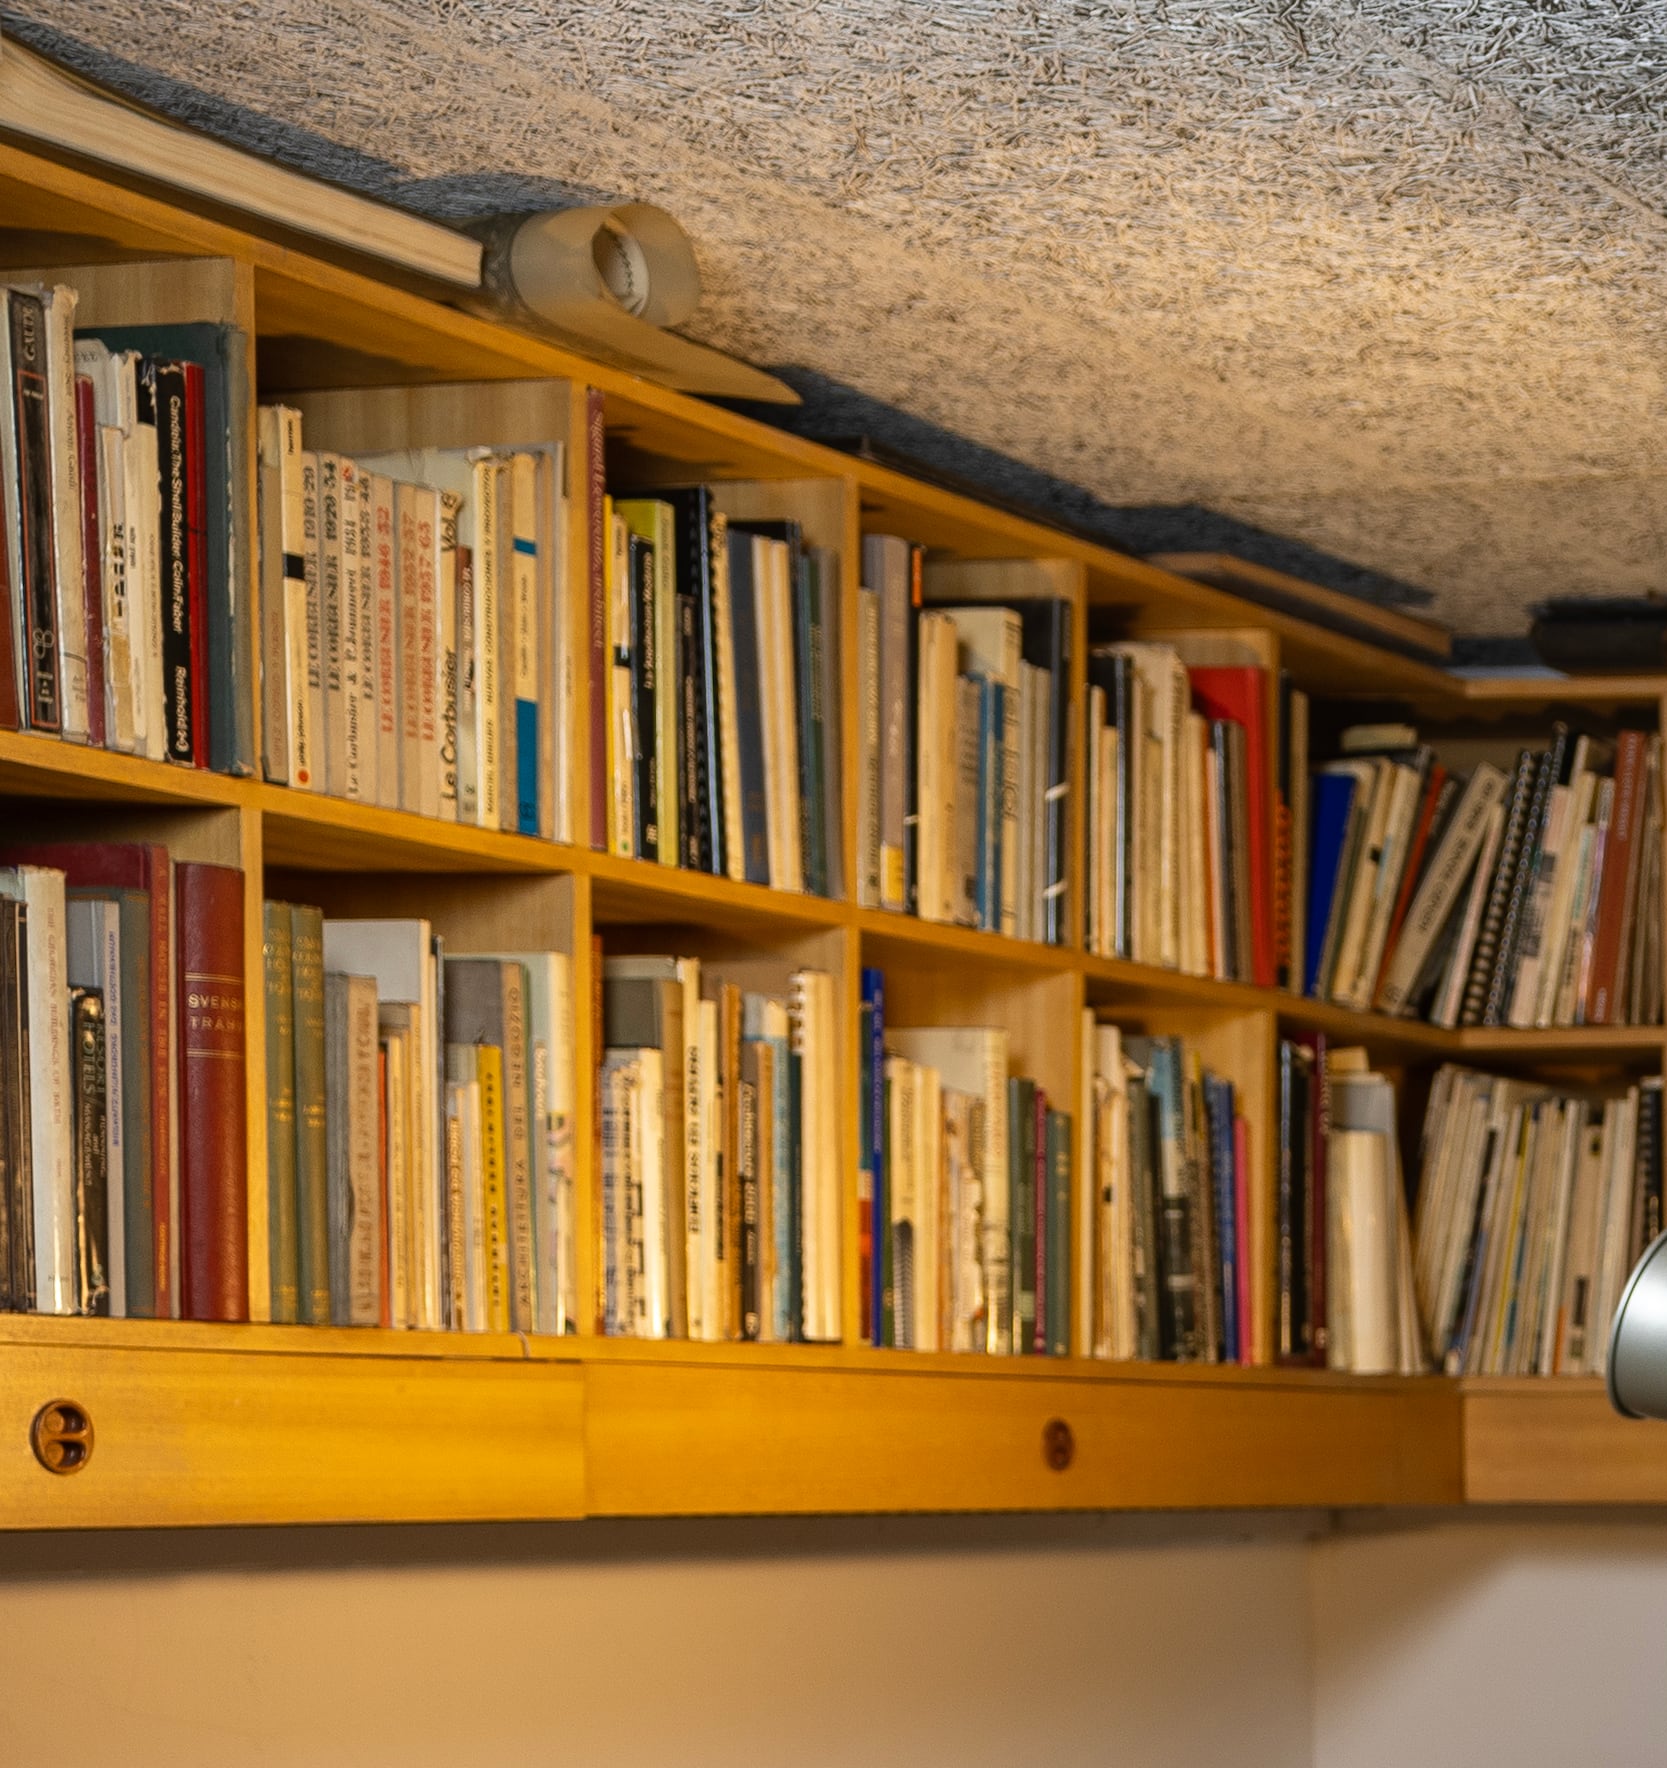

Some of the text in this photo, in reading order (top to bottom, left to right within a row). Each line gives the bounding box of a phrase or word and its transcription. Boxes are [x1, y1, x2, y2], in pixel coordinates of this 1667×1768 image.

[440, 647, 457, 764] Corbusier
[440, 772, 457, 800] Le
[82, 1021, 96, 1095] HOTELS
